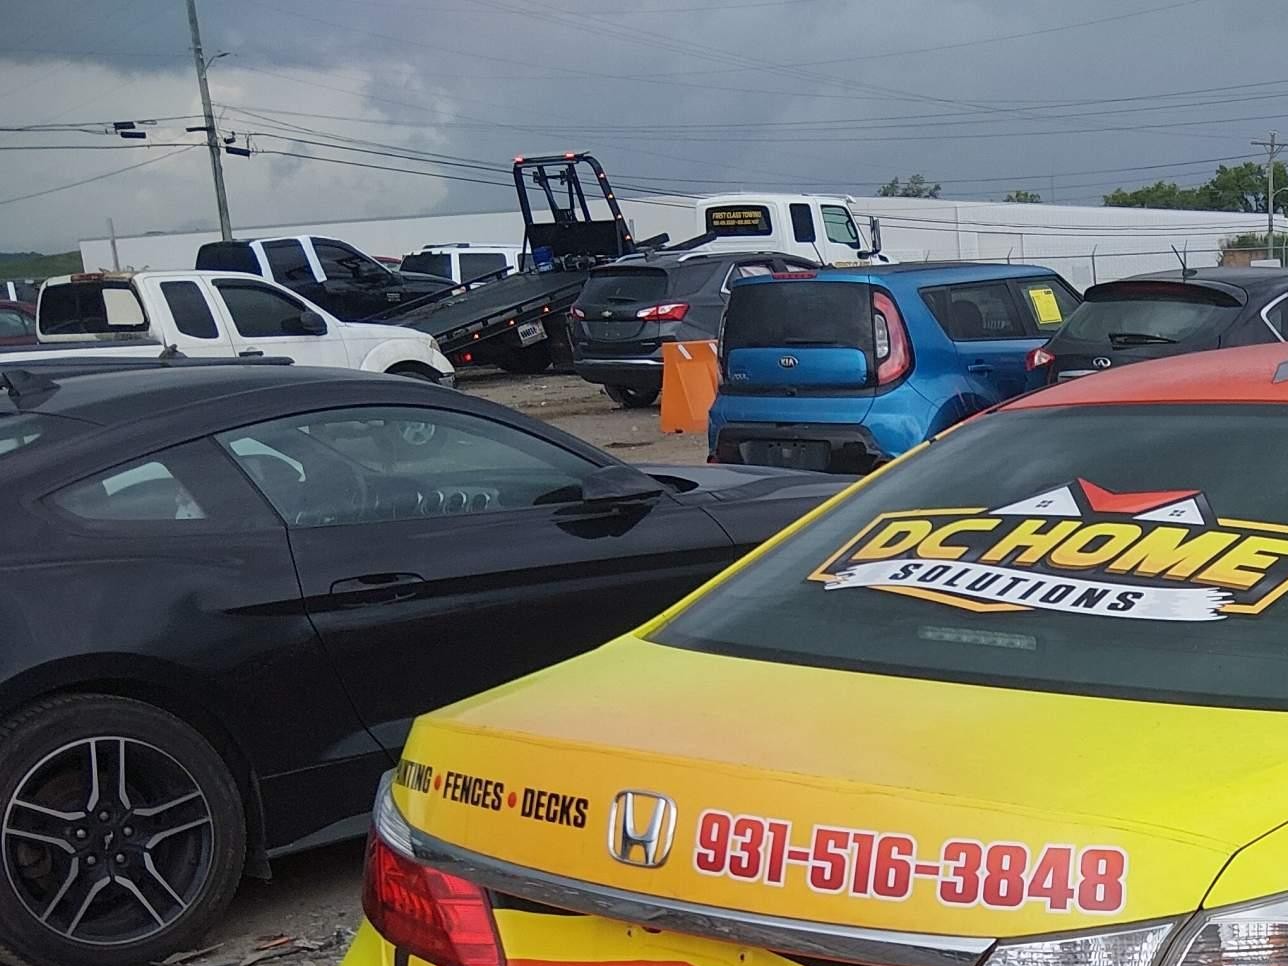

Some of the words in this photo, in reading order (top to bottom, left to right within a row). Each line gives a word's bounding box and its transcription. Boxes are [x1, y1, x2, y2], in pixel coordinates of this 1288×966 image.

[850, 517, 1003, 562] DC
[890, 562, 1144, 613] SOLUTIONS
[442, 771, 505, 811] FENCES
[521, 788, 589, 828] DECKS
[697, 810, 1127, 914] 931-516-3848
